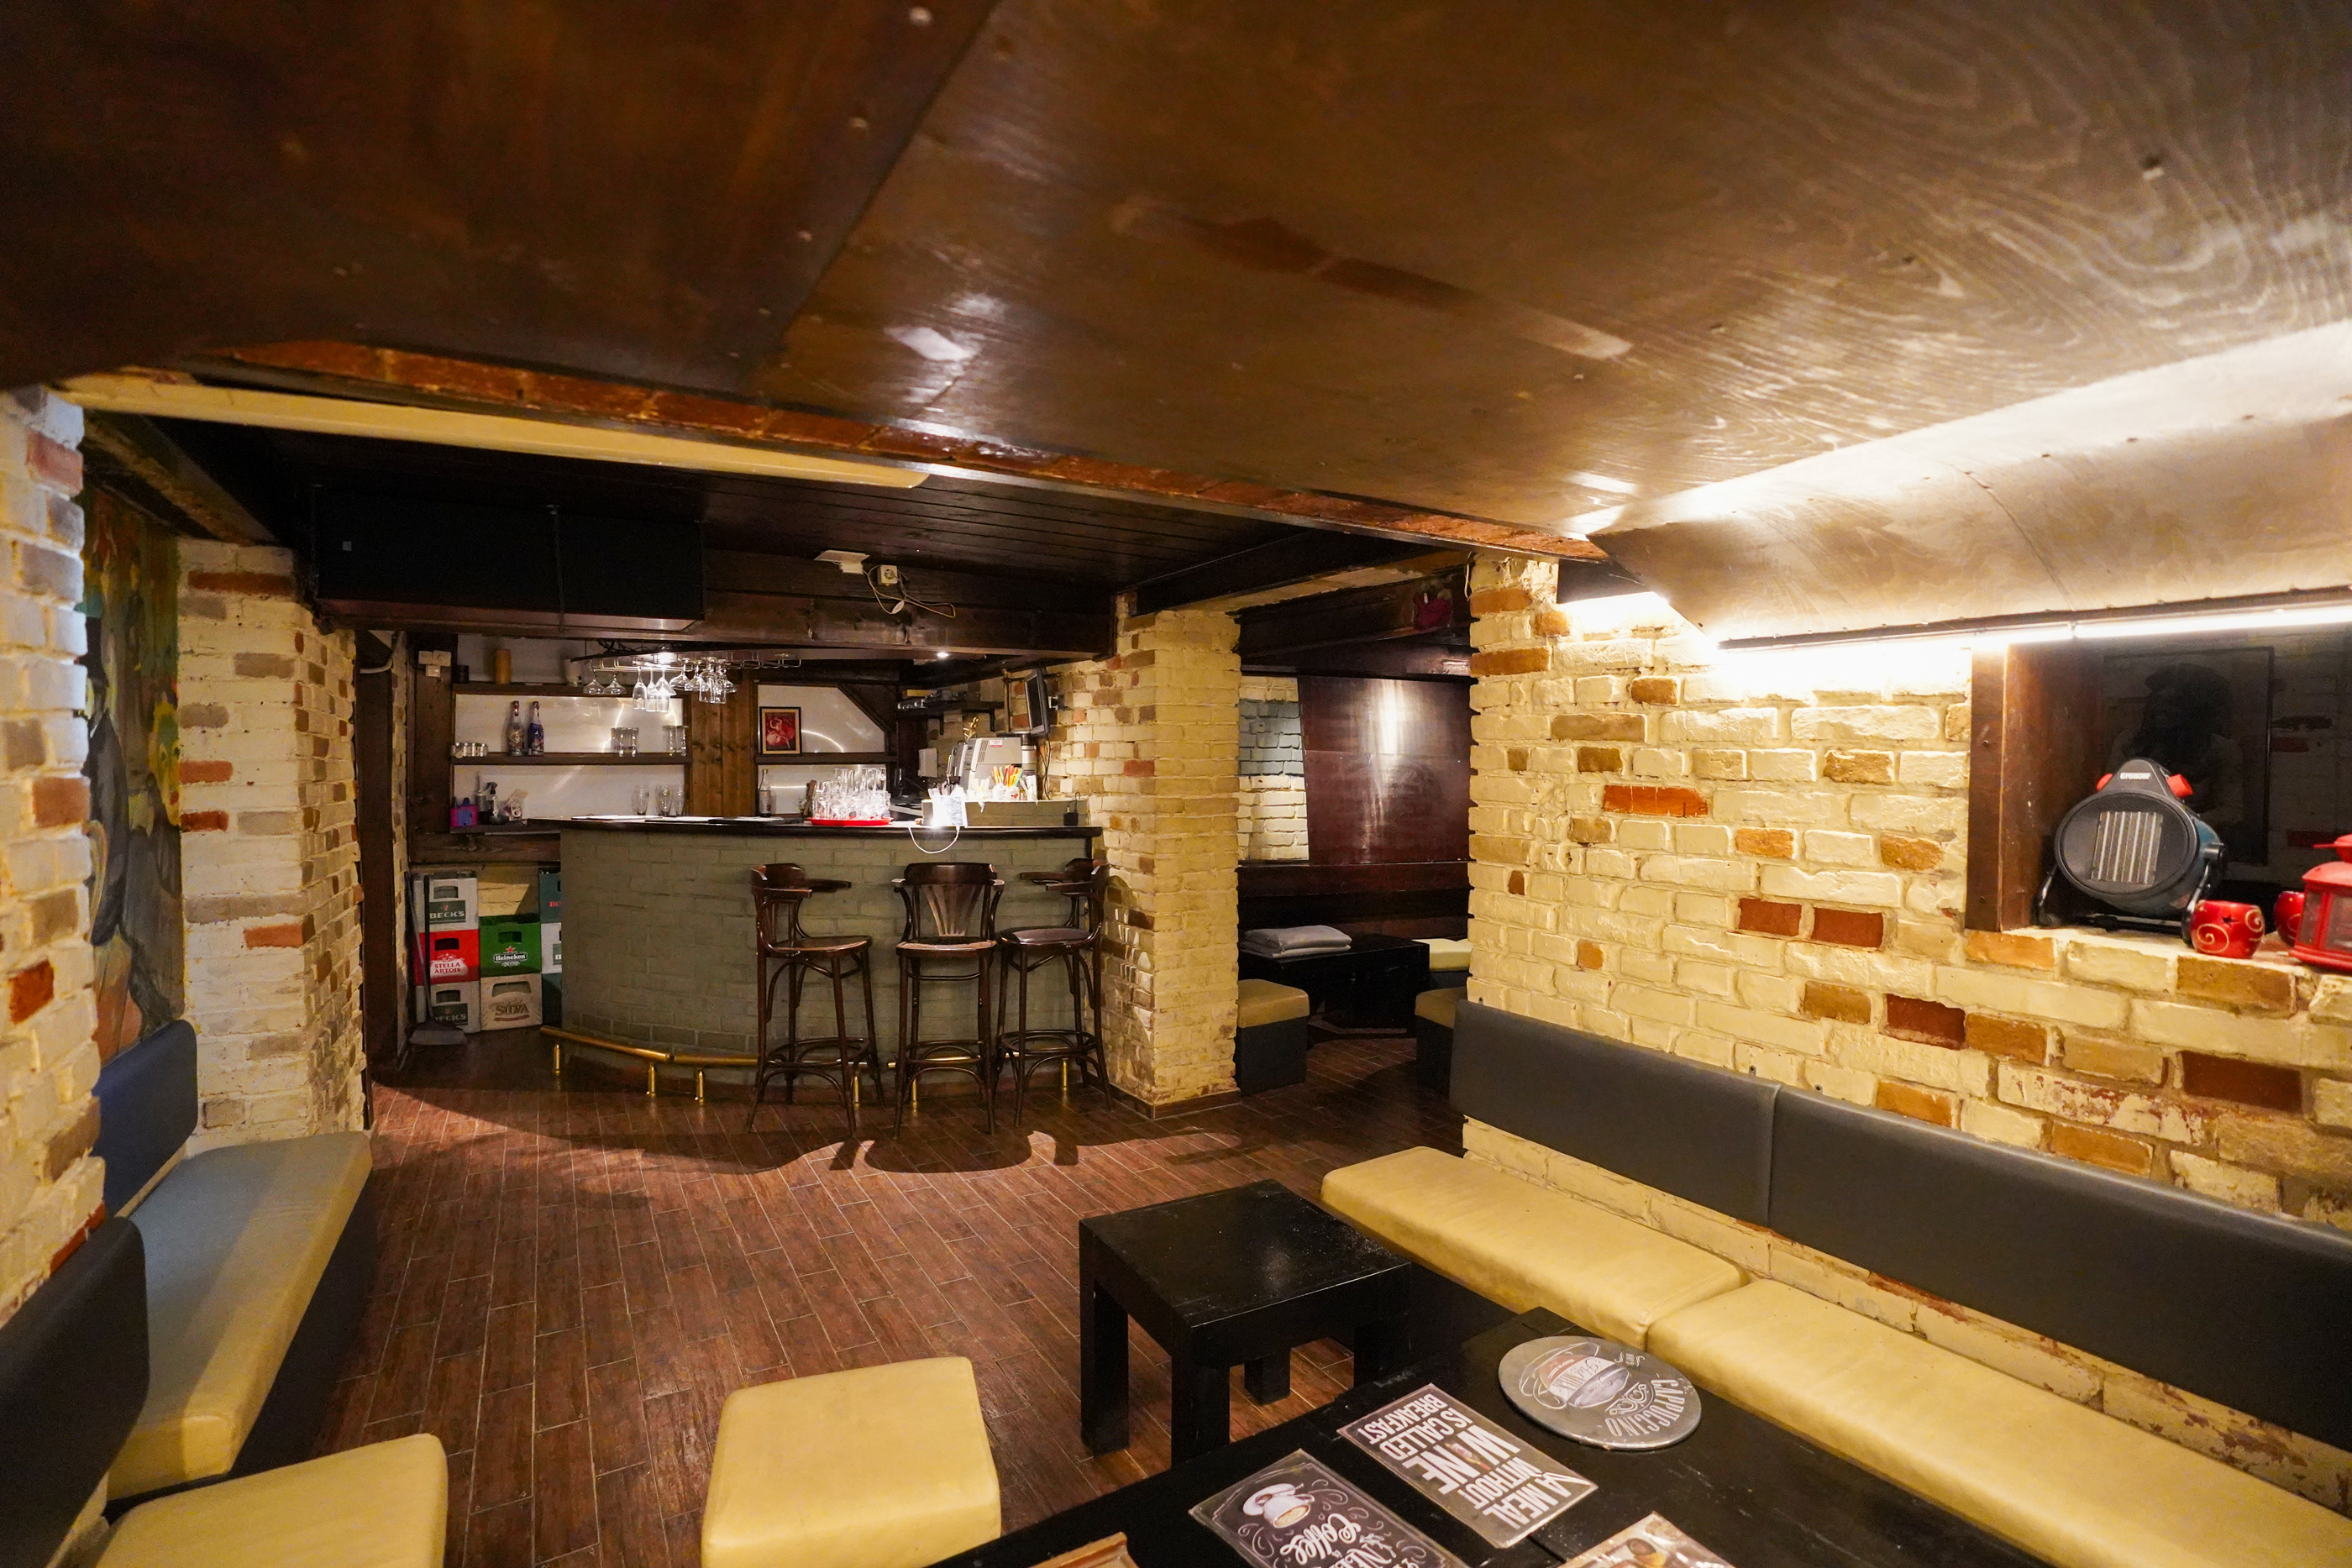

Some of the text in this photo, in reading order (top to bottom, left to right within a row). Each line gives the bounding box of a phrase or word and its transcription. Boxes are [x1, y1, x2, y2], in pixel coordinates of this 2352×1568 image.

[429, 910, 465, 919] BECK'S
[1357, 1393, 1448, 1445] BREAKFAST
[1379, 1407, 1473, 1461] IS CALLED
[1604, 1379, 1686, 1437] CAPPUCCINO
[1457, 1456, 1543, 1510] WITHOUT
[1482, 1472, 1572, 1530] A MEAL
[1279, 1513, 1362, 1565] Coffee
